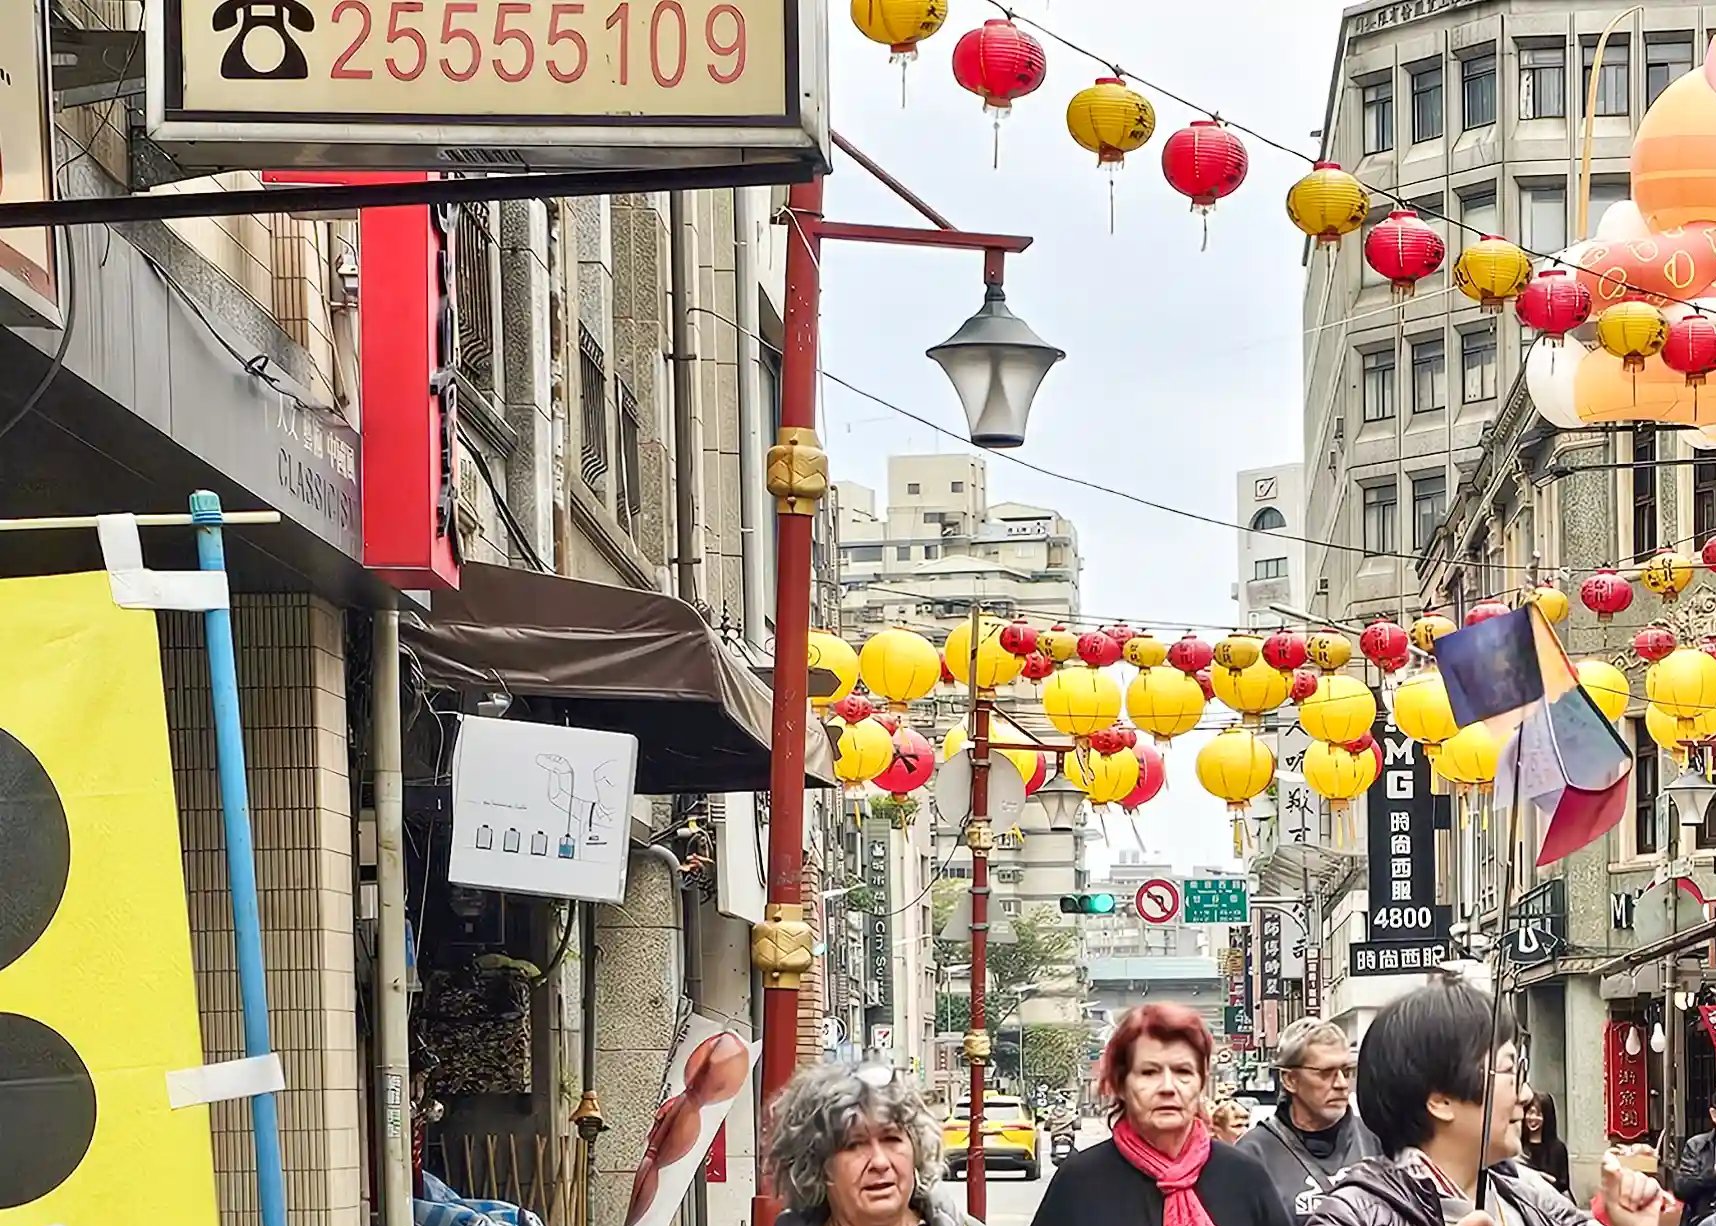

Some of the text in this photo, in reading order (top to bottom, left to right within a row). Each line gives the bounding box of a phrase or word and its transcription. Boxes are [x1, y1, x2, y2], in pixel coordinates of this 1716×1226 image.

[330, 0, 747, 88] 25555109
[1389, 811, 1412, 901] 時尚西服
[1373, 906, 1432, 929] 4800
